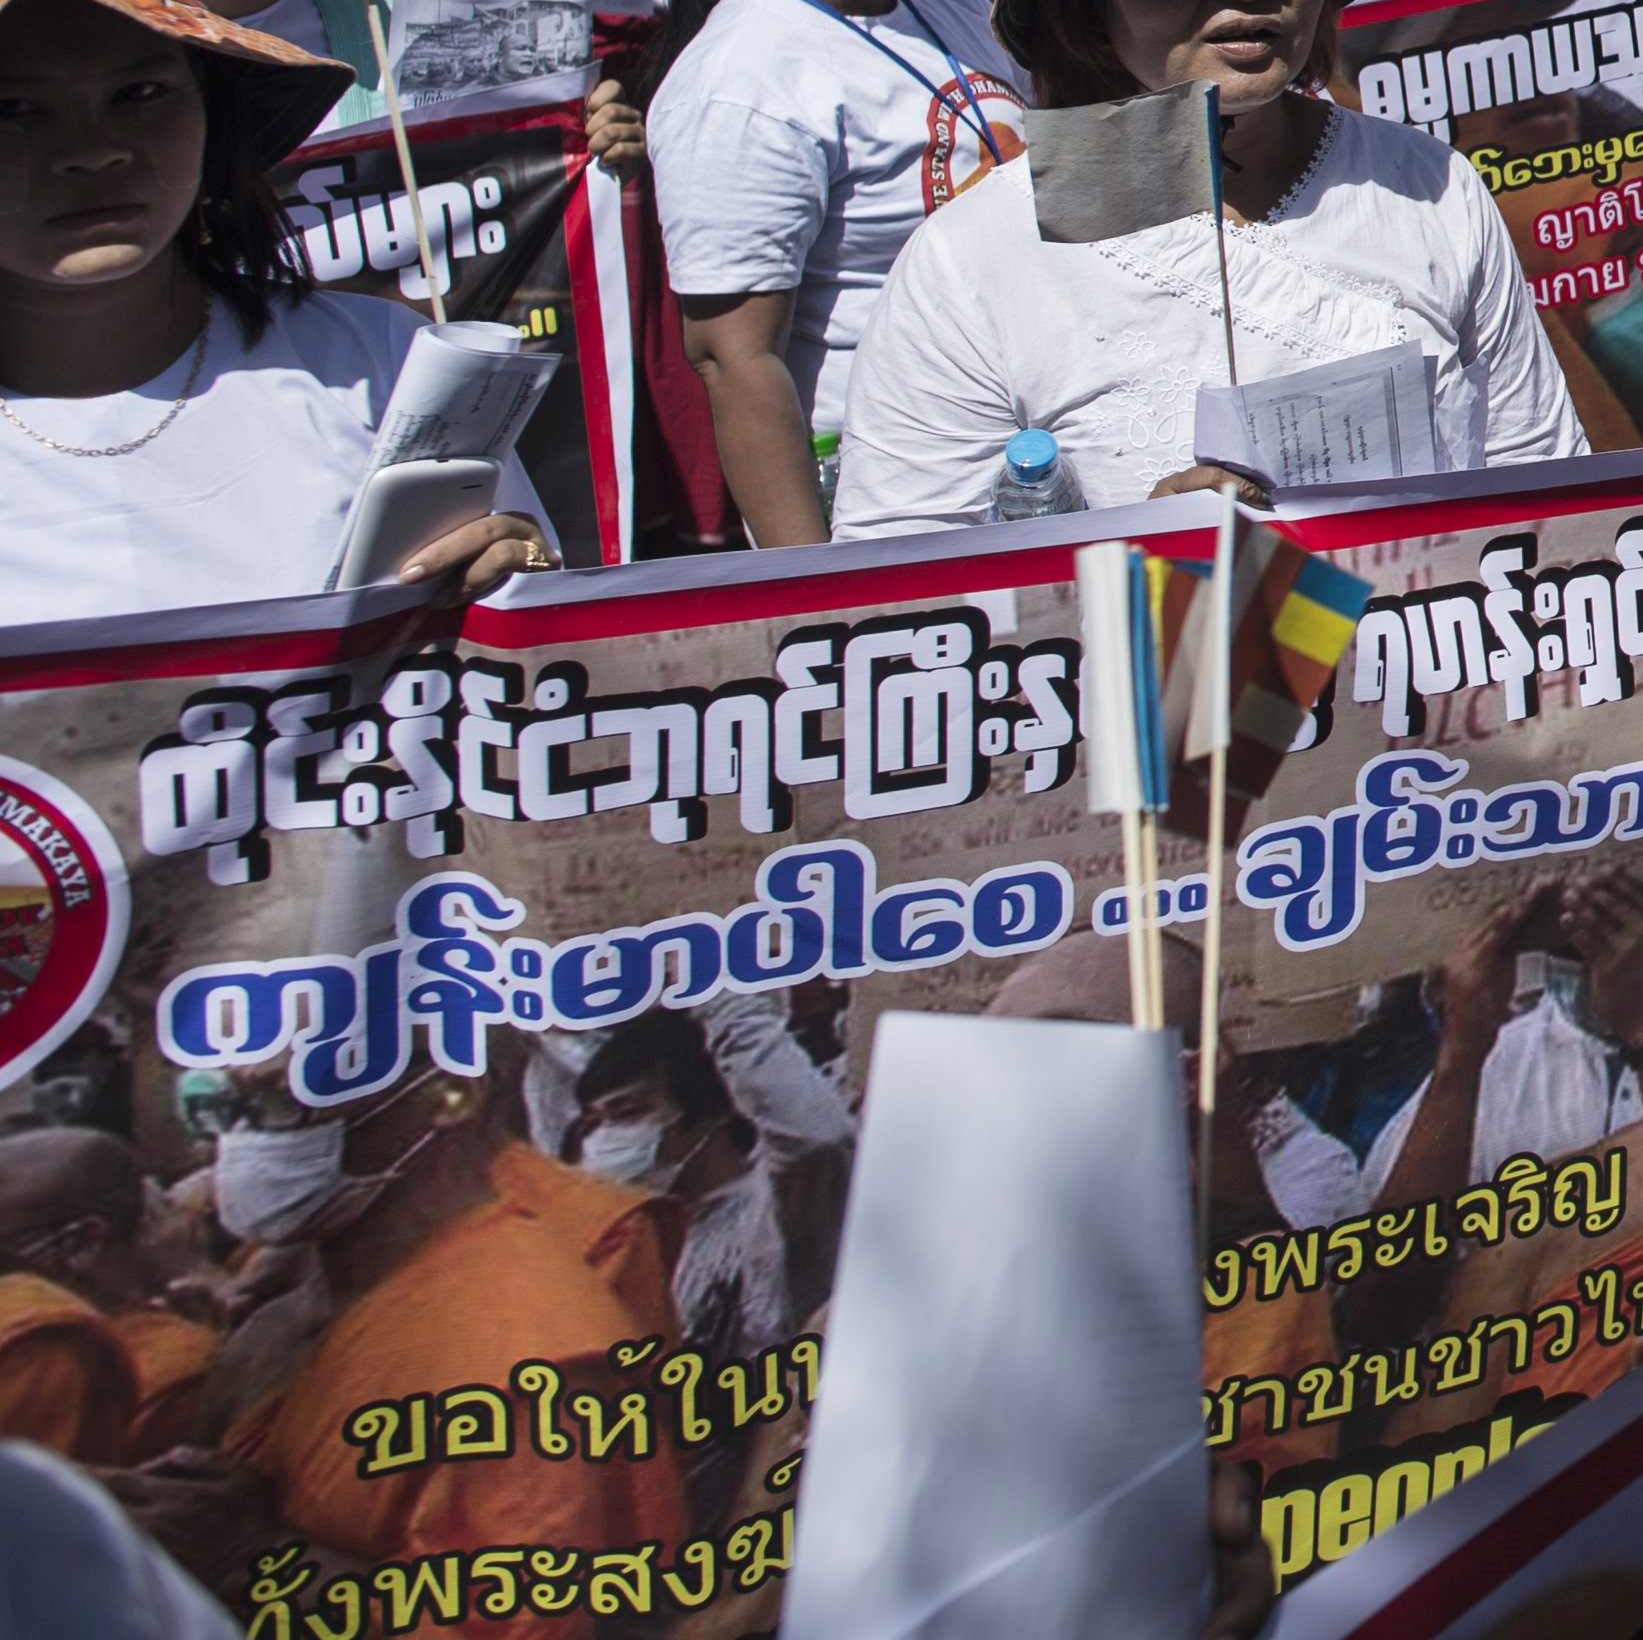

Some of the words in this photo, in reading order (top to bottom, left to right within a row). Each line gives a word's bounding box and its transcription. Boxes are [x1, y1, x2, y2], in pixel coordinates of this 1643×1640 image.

[0, 792, 91, 909] MAKAYA
[140, 620, 1092, 888] ထိုင်းနိုင်ငံဘုရင်ကြီးနှ
[162, 843, 1071, 1103] ကျန်းမာပါစေ
